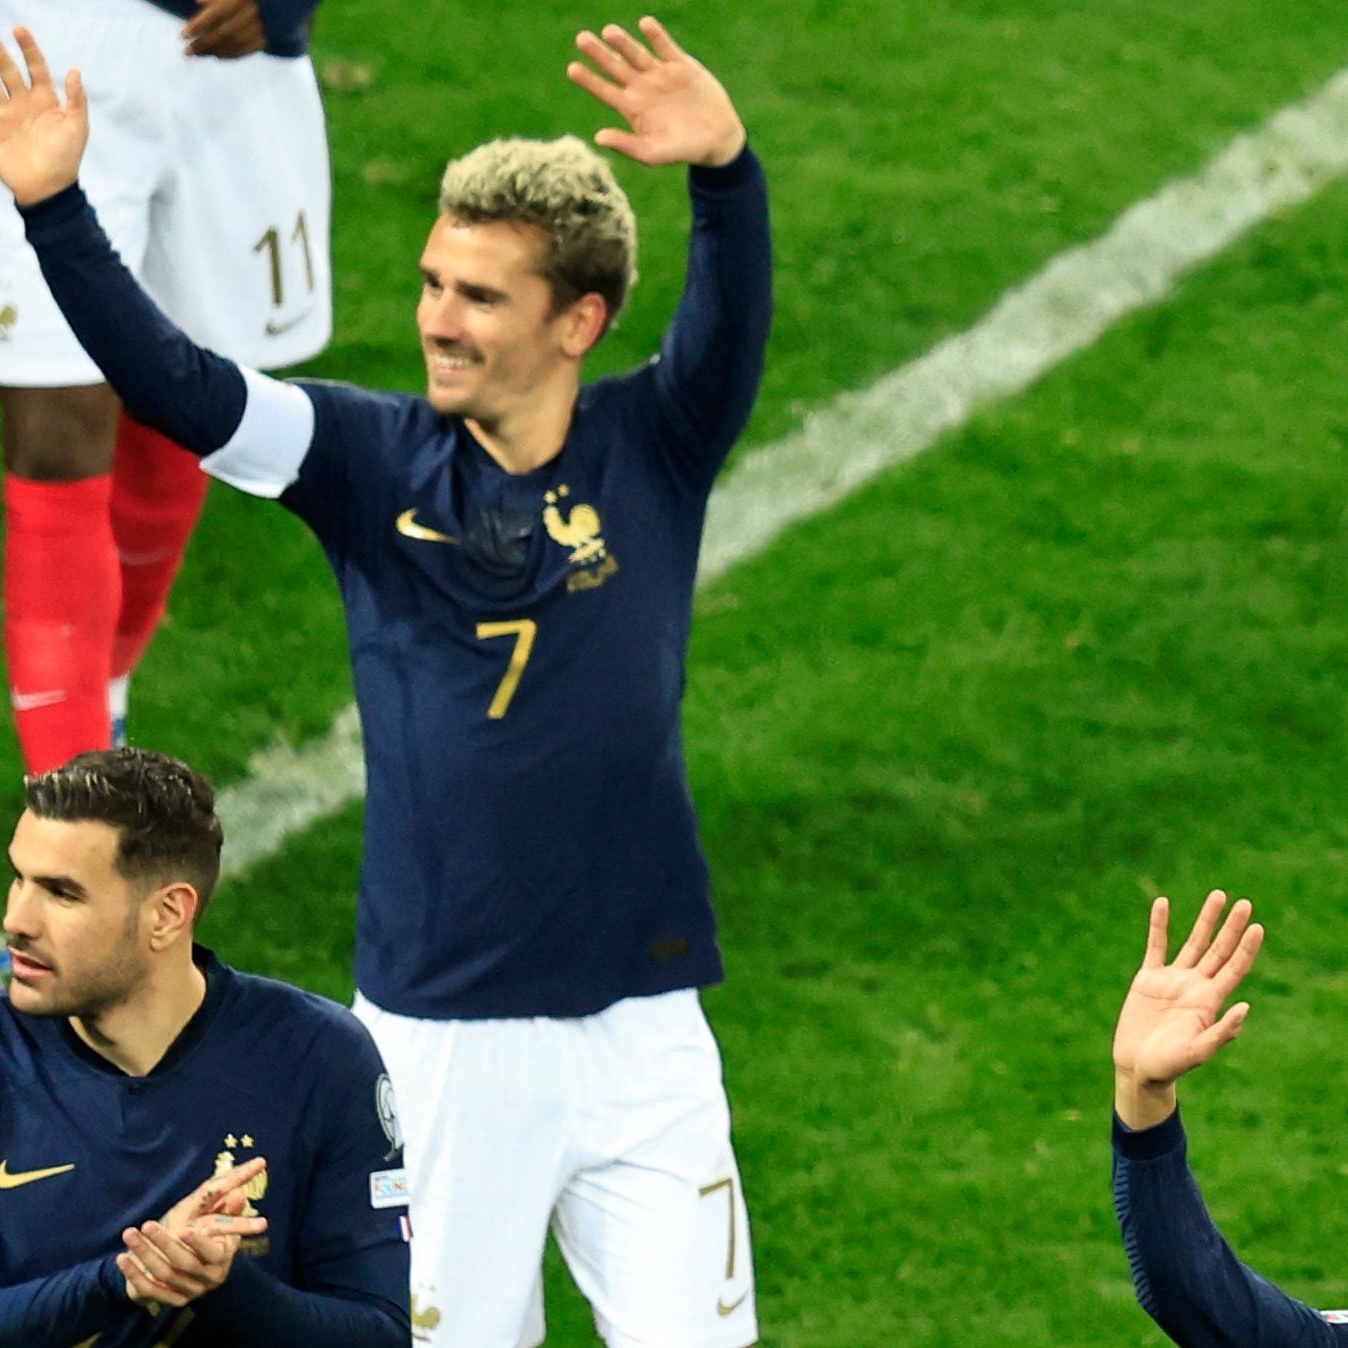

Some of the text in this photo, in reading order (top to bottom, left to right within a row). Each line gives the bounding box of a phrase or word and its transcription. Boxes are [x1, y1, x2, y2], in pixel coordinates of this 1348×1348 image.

[254, 209, 315, 308] 11
[476, 617, 537, 719] 7
[699, 1177, 735, 1280] 7
